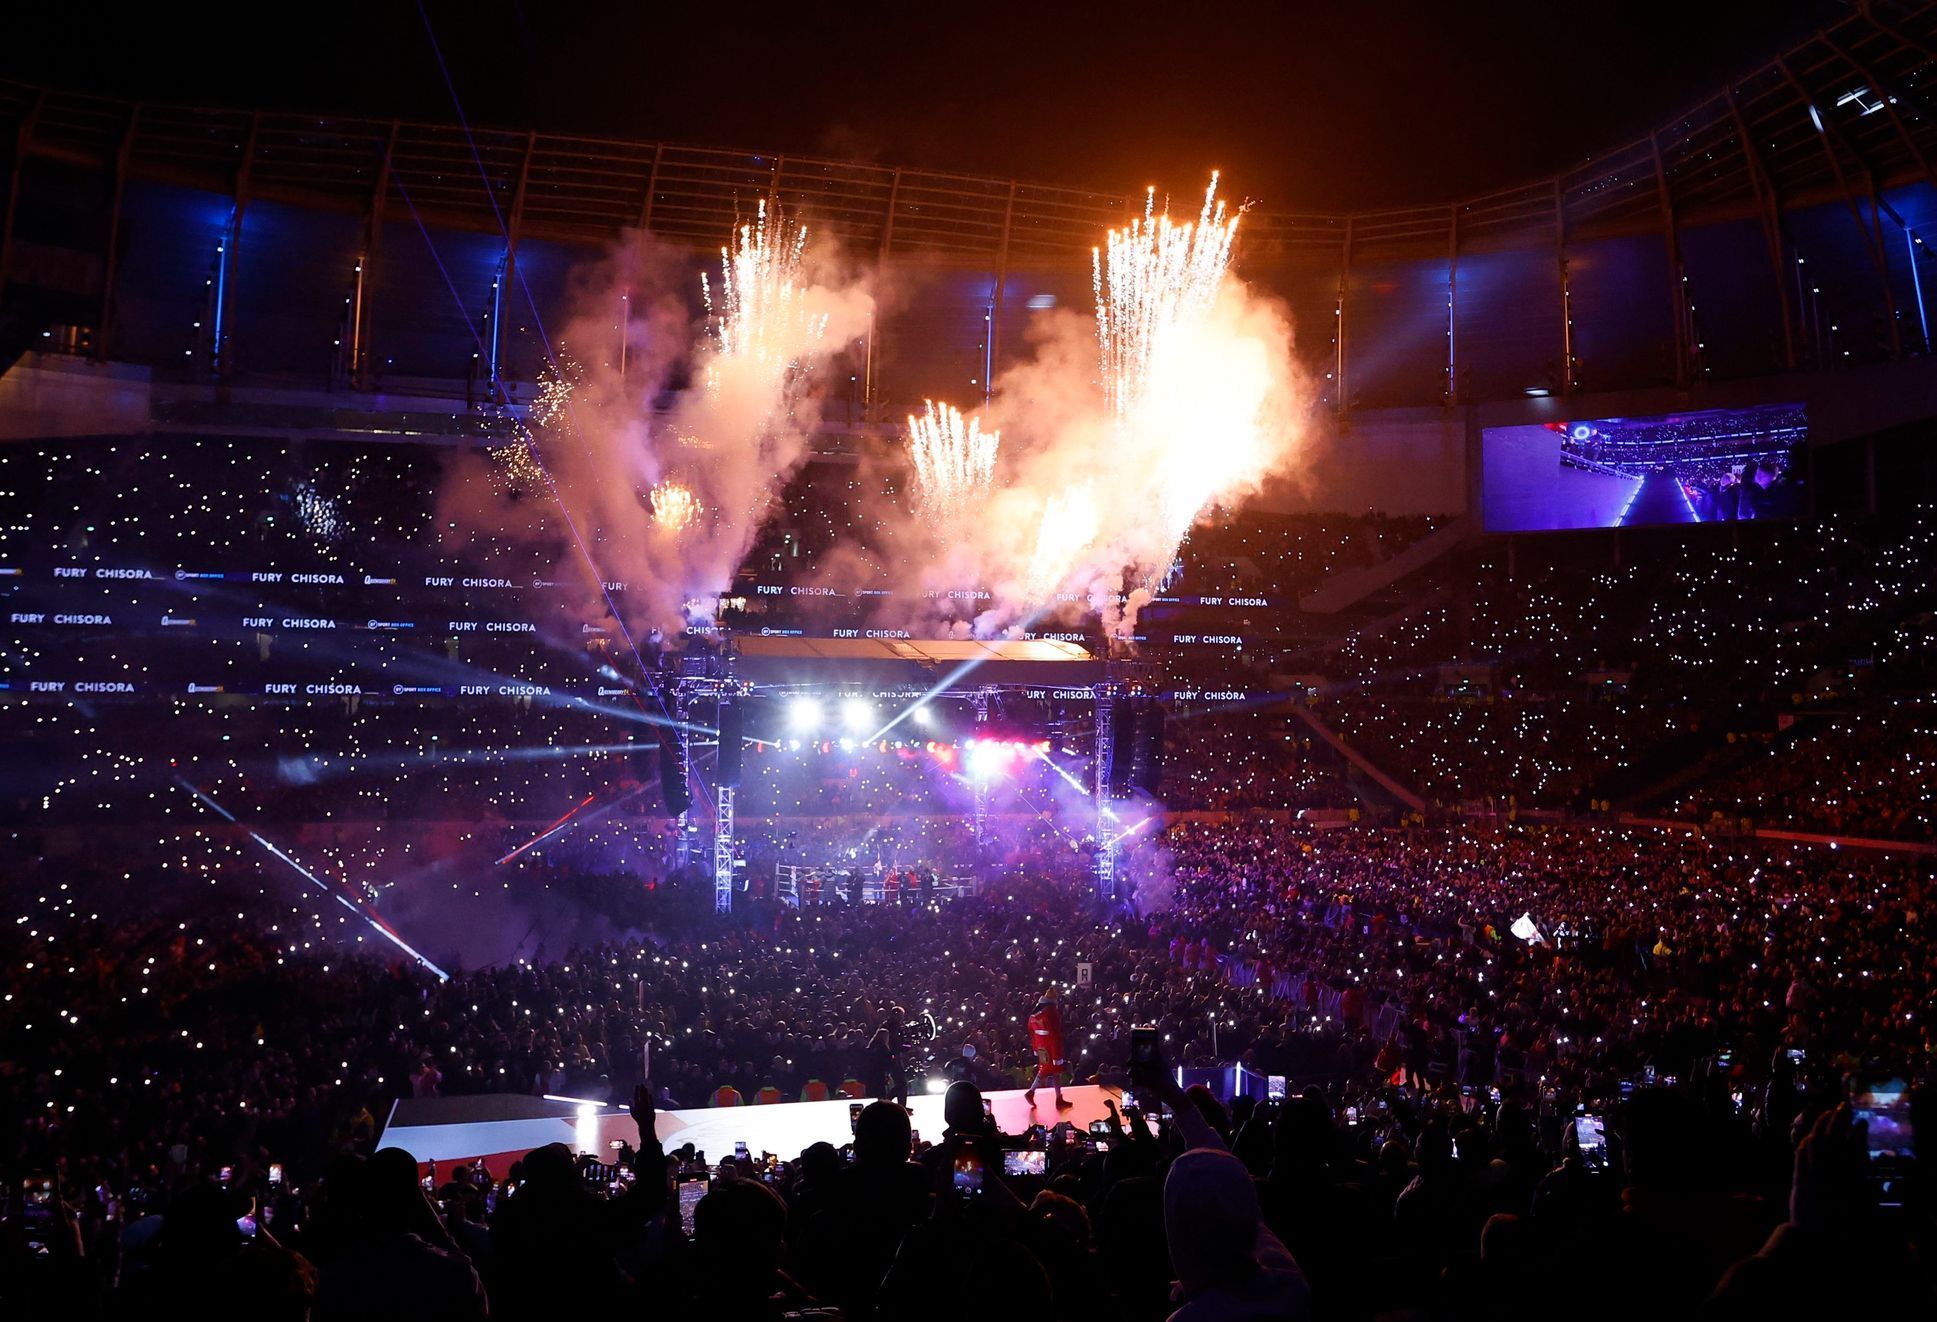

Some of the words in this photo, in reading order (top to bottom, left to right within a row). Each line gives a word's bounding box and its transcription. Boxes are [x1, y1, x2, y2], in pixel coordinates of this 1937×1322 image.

[54, 568, 87, 578] FURY
[96, 568, 152, 579] CHISORA
[252, 573, 282, 582] FURY
[291, 573, 344, 584] CHISORA
[426, 577, 454, 586] FURY
[462, 578, 512, 588] CHISORA
[601, 582, 628, 591] FURY
[757, 586, 783, 595] FURY
[790, 586, 836, 596] CHISORA
[948, 591, 991, 600] CHISORA
[1057, 594, 1079, 602] FURY
[1087, 595, 1128, 603] CORA
[1200, 597, 1222, 606] FURY
[1229, 598, 1268, 607] CHISORA
[11, 613, 45, 624] FURY
[54, 614, 111, 625] CHISORA
[243, 617, 273, 628] FURY
[282, 618, 336, 629] CHISORA
[449, 622, 477, 631] FURY
[486, 622, 536, 633] CHISORA
[686, 626, 732, 635] CHIS
[833, 629, 859, 638] FURY
[866, 630, 911, 639] CHISORA
[1043, 633, 1086, 642] CHISORA
[1174, 635, 1197, 644] FURY
[1203, 635, 1243, 645] CHISORA
[31, 682, 65, 692] FURY
[75, 682, 134, 693] CHISORA
[265, 684, 297, 694] FURY
[306, 684, 362, 695] CHISORA
[460, 686, 490, 695] FURY
[499, 686, 551, 696] CHISORA
[1026, 690, 1046, 699] URY
[1053, 690, 1097, 700] CHISORA
[1174, 691, 1197, 700] FURY
[1204, 691, 1246, 701] CHISORA
